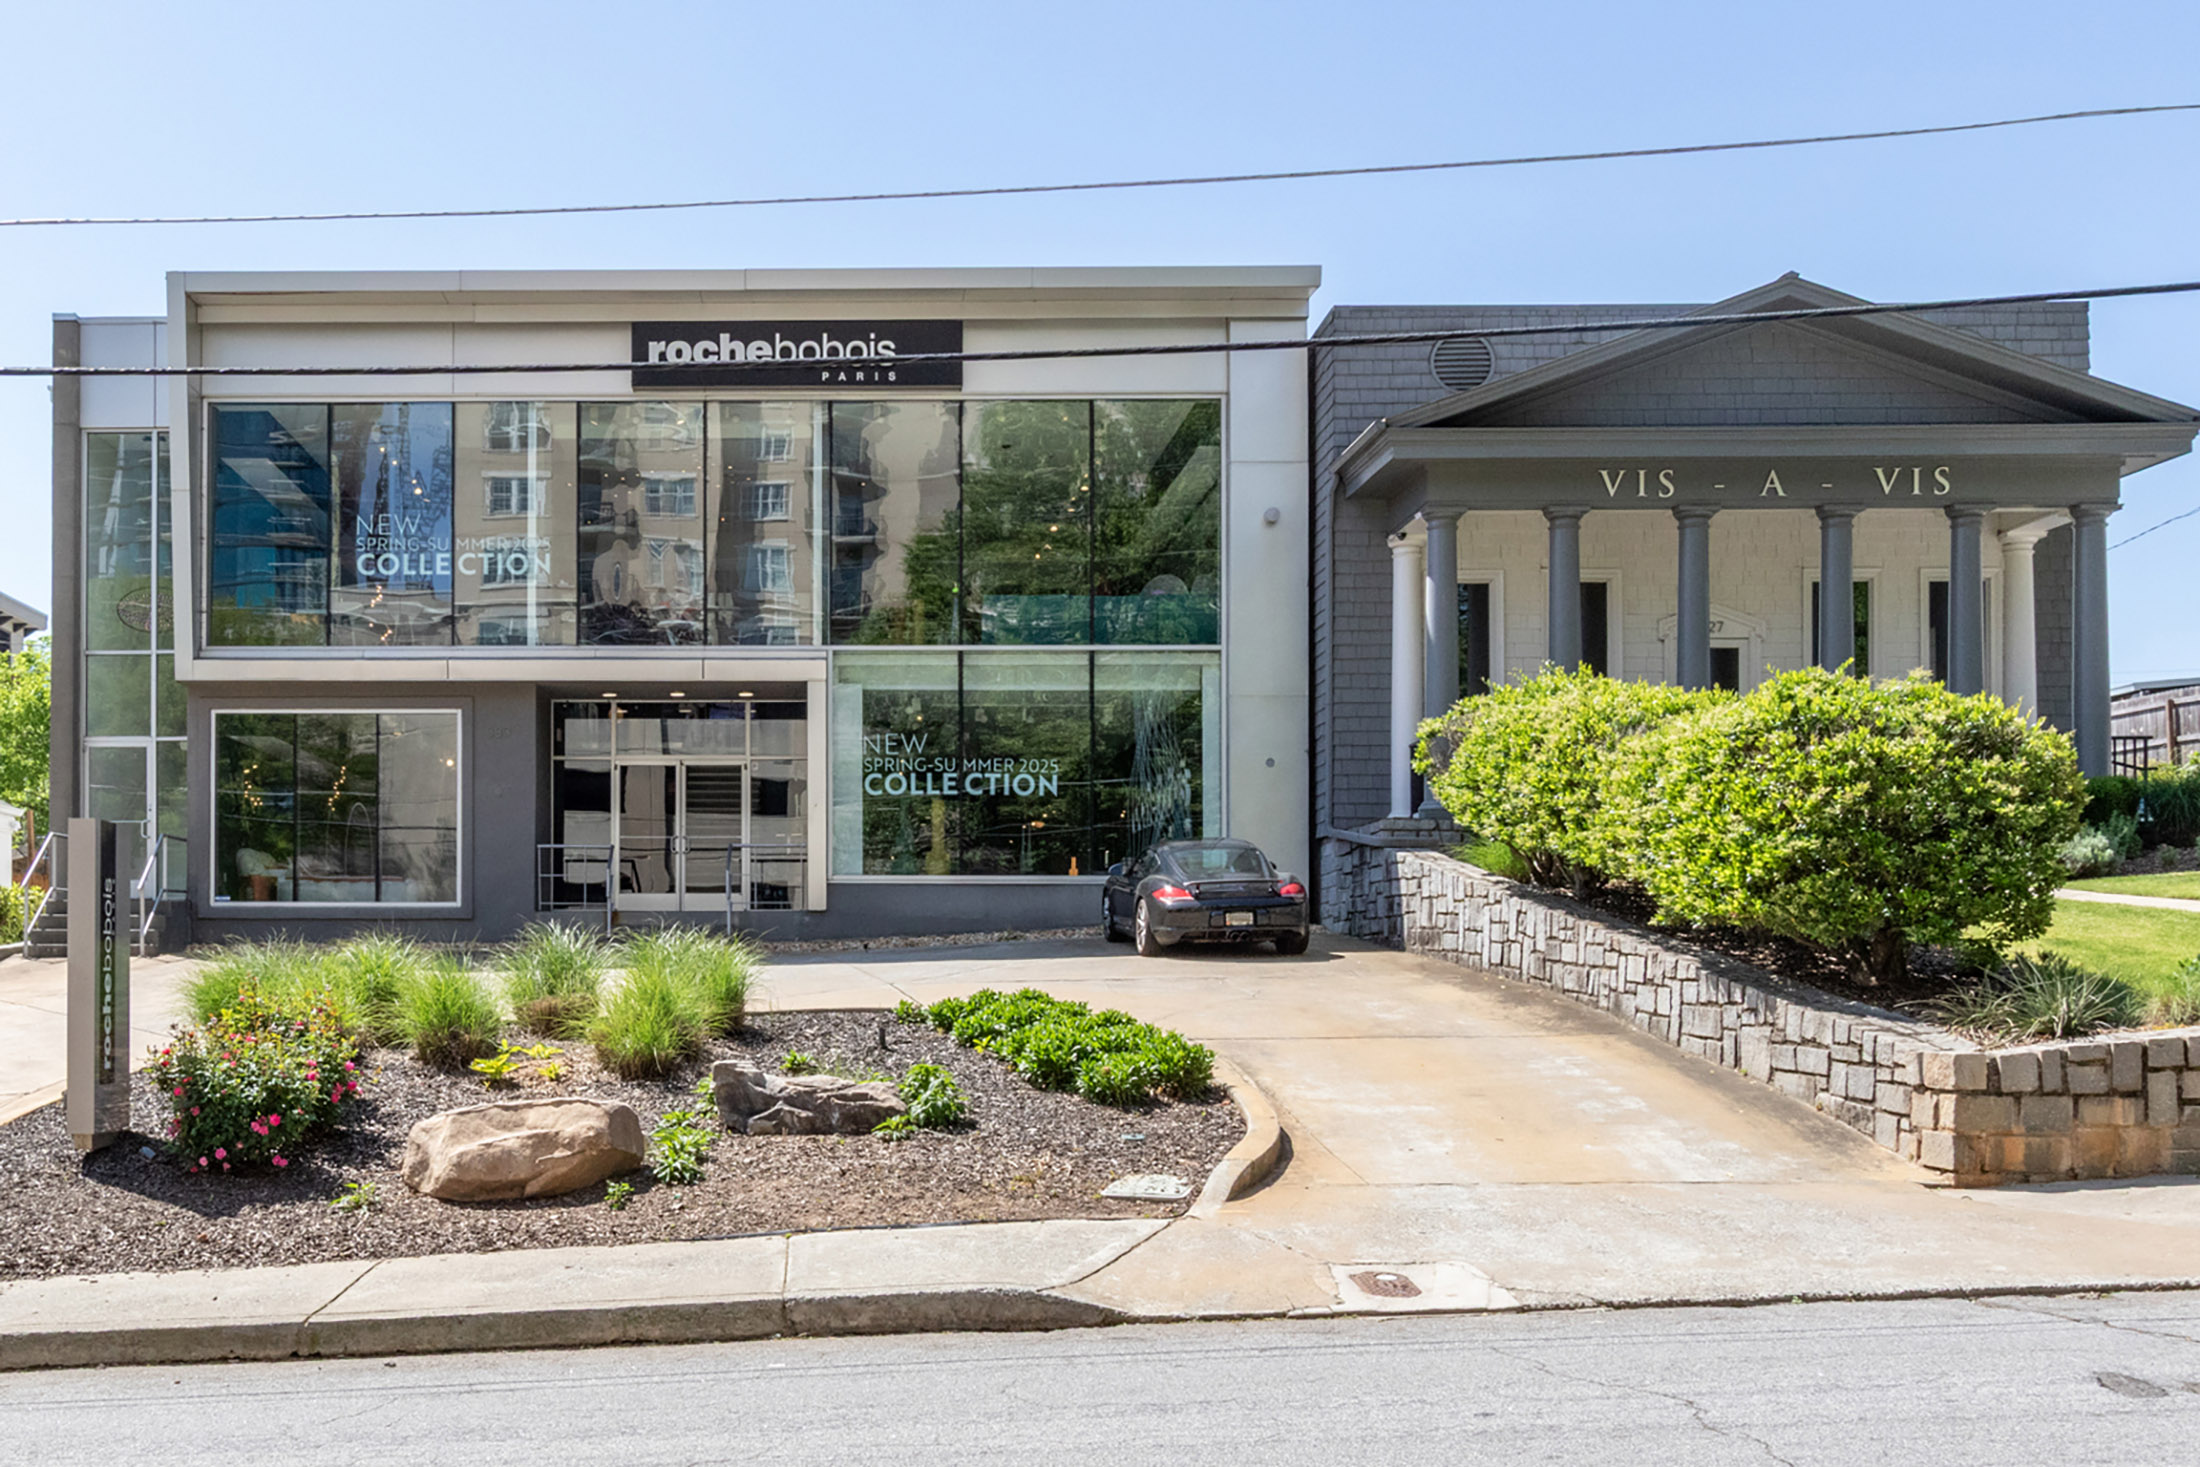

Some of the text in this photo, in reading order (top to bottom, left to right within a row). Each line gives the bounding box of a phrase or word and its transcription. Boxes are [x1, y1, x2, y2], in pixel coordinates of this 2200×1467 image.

[648, 333, 897, 366] rochebobois
[821, 372, 896, 382] PARIS
[1599, 469, 1675, 499] VIS
[1759, 470, 1788, 498] A
[1873, 466, 1951, 496] VIS
[356, 513, 420, 535] NEW
[356, 553, 551, 576] COLLECTION
[863, 733, 928, 755] NEW
[1018, 758, 1059, 774] 2025
[864, 773, 1058, 797] COLLECTION
[103, 878, 113, 1070] rochebobois
